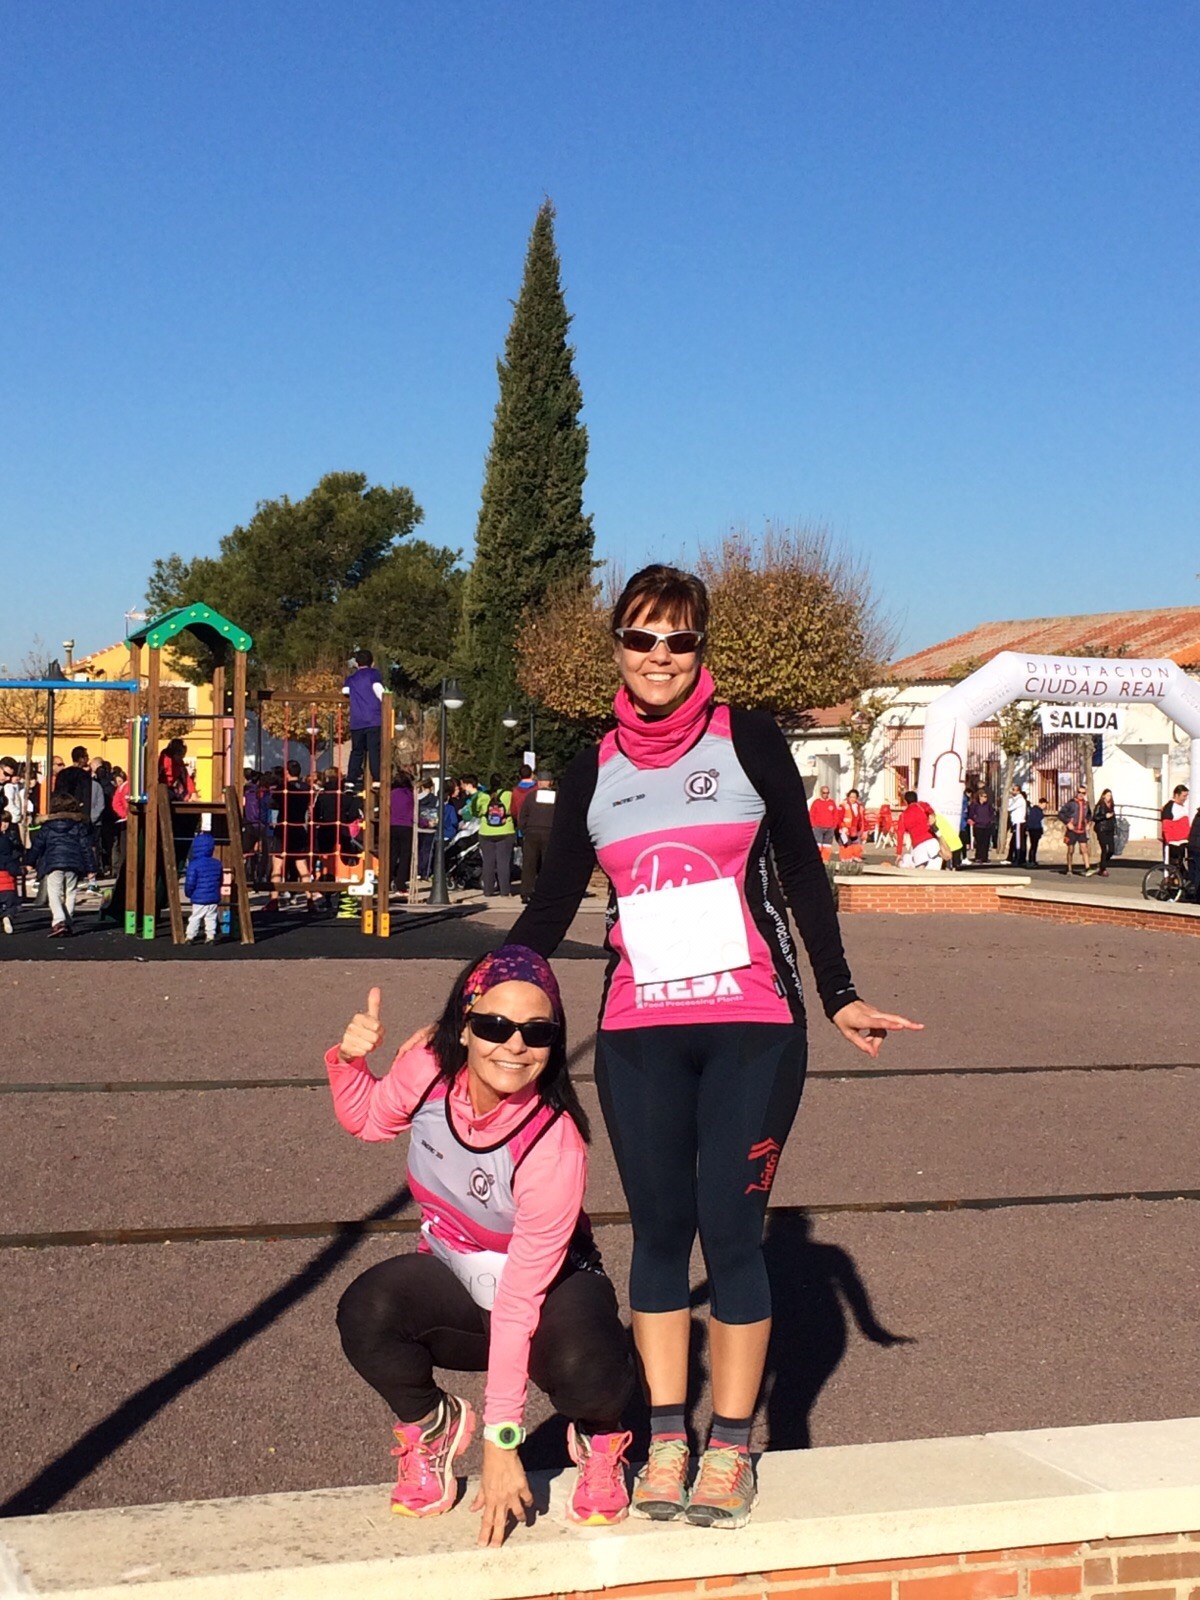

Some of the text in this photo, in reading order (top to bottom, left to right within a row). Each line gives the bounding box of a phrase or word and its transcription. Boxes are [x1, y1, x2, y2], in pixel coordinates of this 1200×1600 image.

[1026, 661, 1169, 679] DIPUTACION
[1024, 678, 1108, 697] CIUDAD
[1119, 681, 1165, 697] REAL
[1049, 710, 1119, 731] SALIDA
